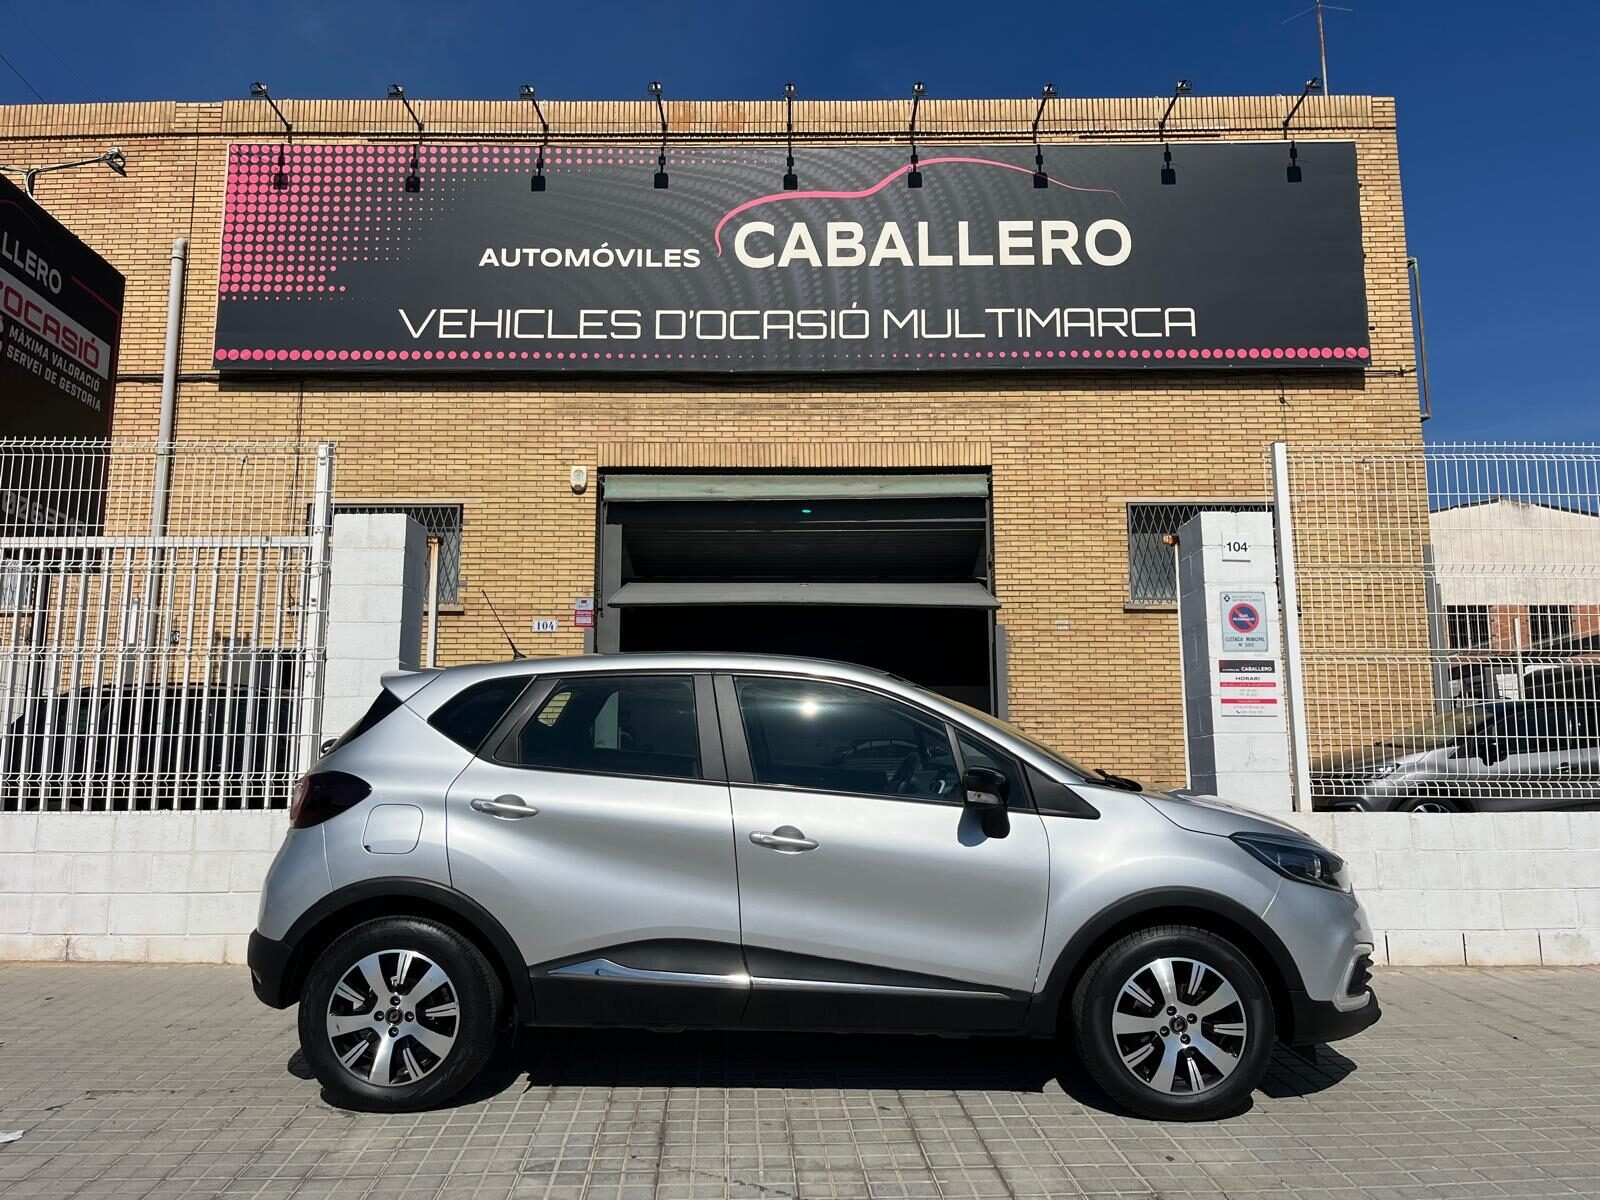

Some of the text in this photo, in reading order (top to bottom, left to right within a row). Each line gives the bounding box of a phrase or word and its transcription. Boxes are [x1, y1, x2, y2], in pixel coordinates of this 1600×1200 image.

[479, 218, 1132, 269] AUTOMÓVILES CABALLERO
[398, 302, 1197, 340] VEHICLES D'OCASIÓ MULTIMARCA
[7, 344, 101, 412] SERVEI DE GESTORIA
[9, 324, 100, 392] MÀXIMA VALORACIÓ
[1226, 541, 1248, 552] 104
[537, 621, 554, 631] 104
